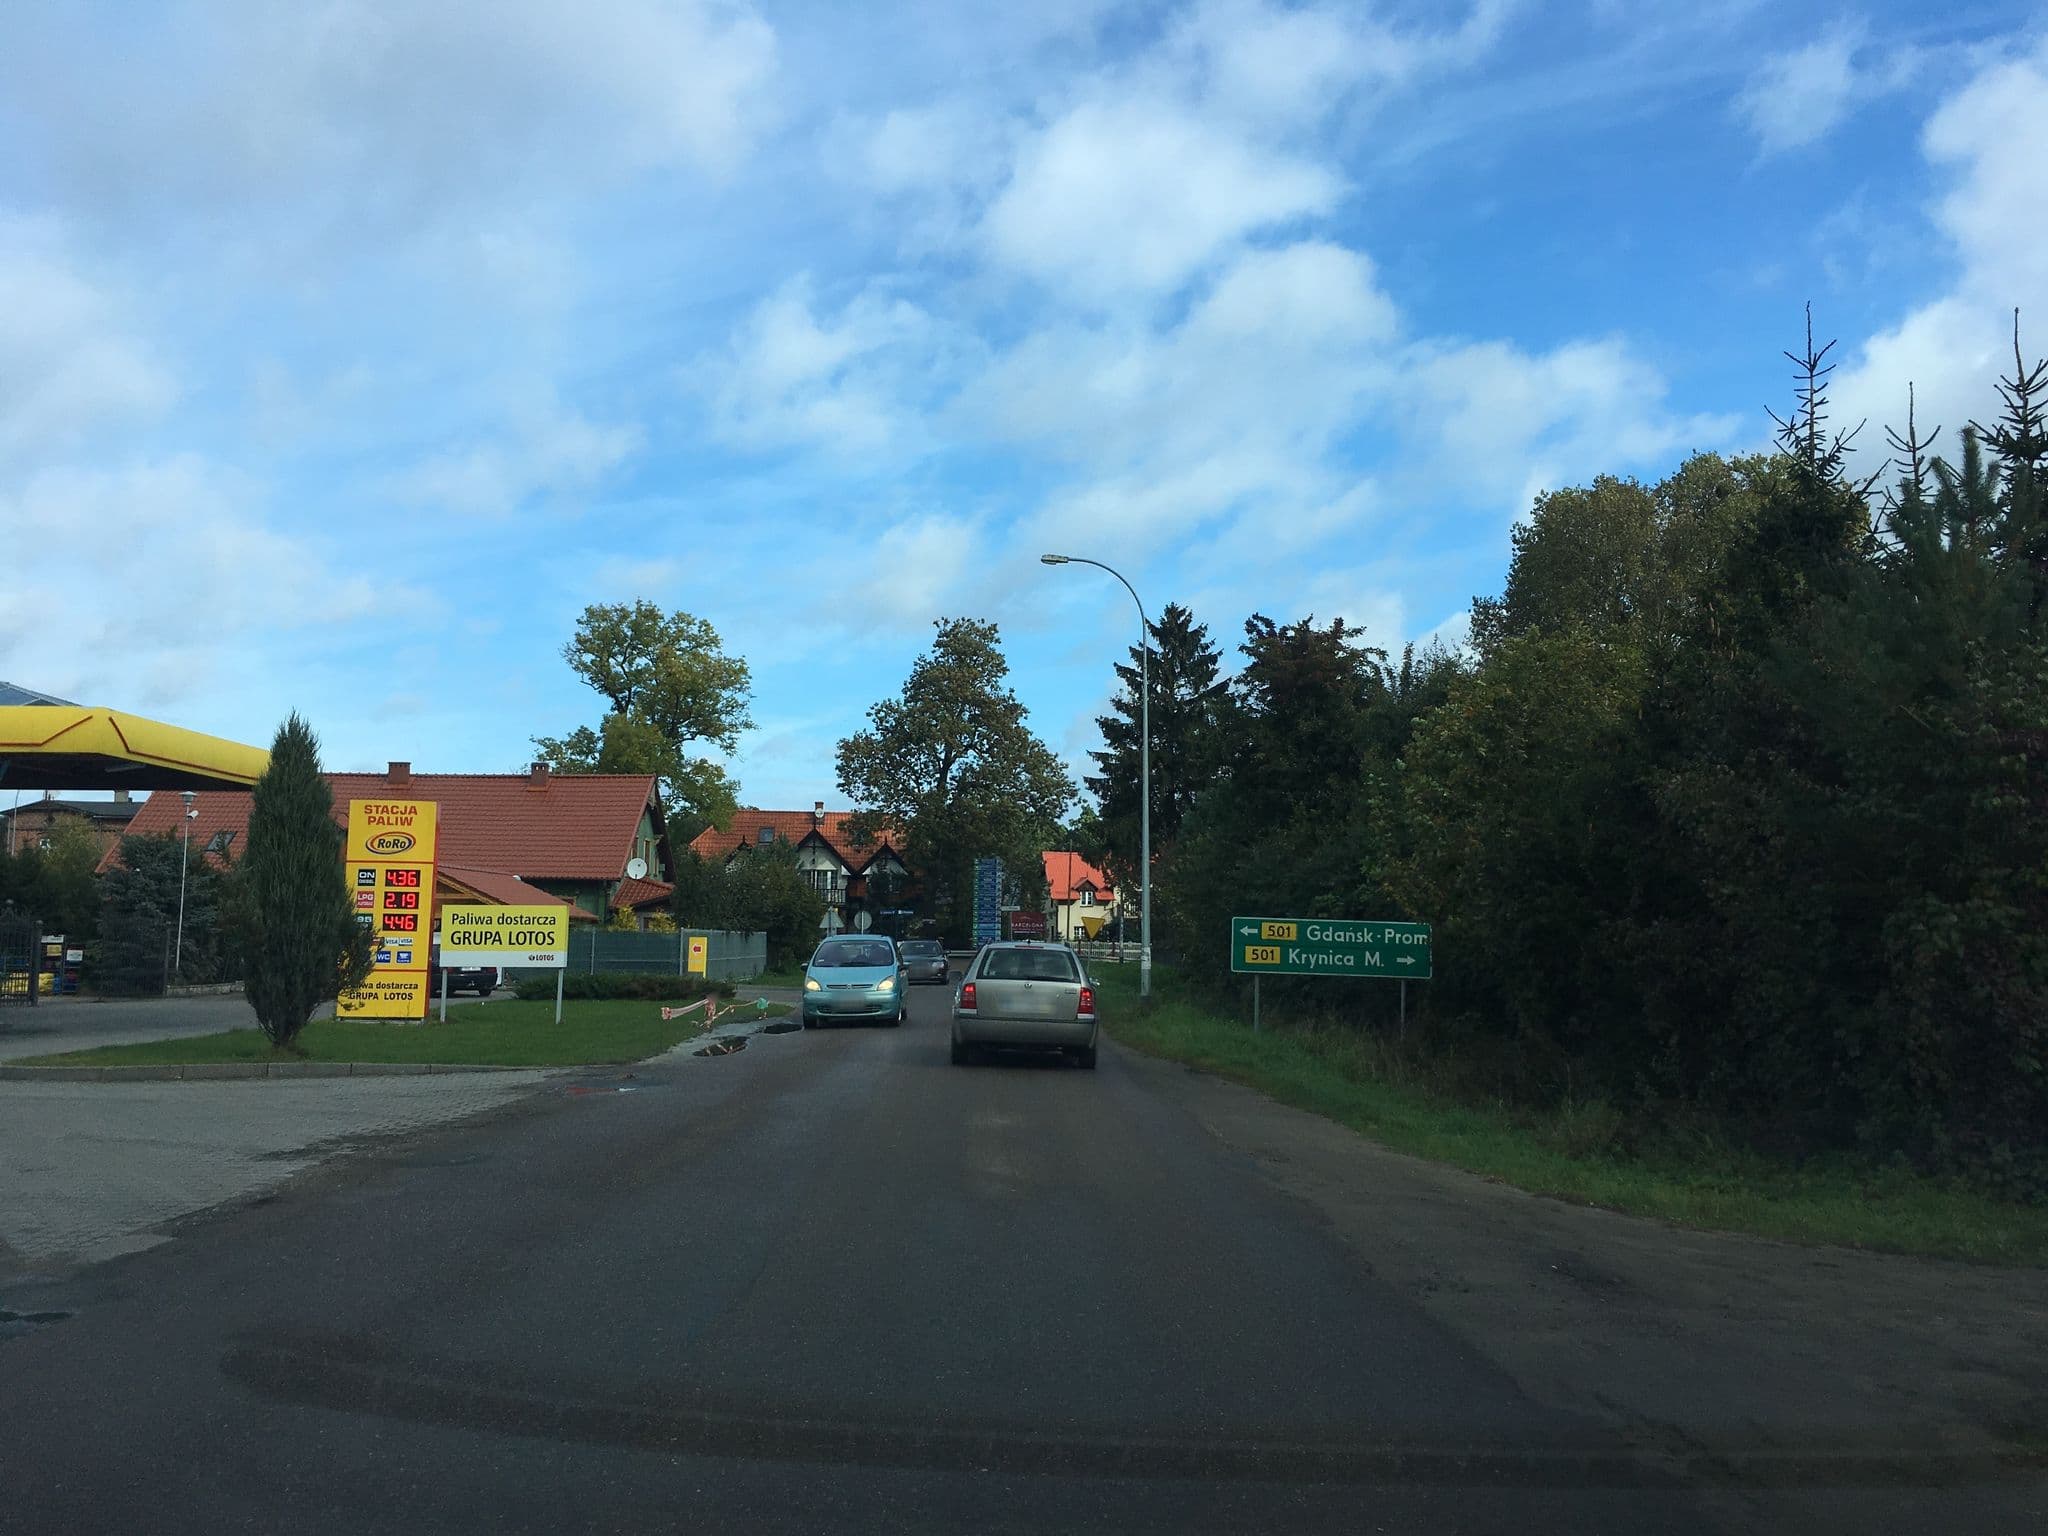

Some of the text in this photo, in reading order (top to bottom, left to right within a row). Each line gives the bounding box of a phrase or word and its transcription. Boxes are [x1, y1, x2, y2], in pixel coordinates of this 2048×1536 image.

[364, 804, 418, 816] STACJA
[367, 816, 414, 827] PALIW
[377, 838, 407, 849] RoRo
[387, 871, 417, 886] 4.36
[386, 893, 416, 908] 2.19
[384, 916, 414, 930] 4.46
[451, 912, 556, 926] Paliwa dostarcza
[451, 931, 555, 945] GRUPA LOTOS
[1267, 925, 1291, 938] 501
[1251, 948, 1386, 969] 501 Krynica M.
[375, 981, 419, 990] dostarcza
[349, 992, 414, 1001] GRUPA LOTOS
